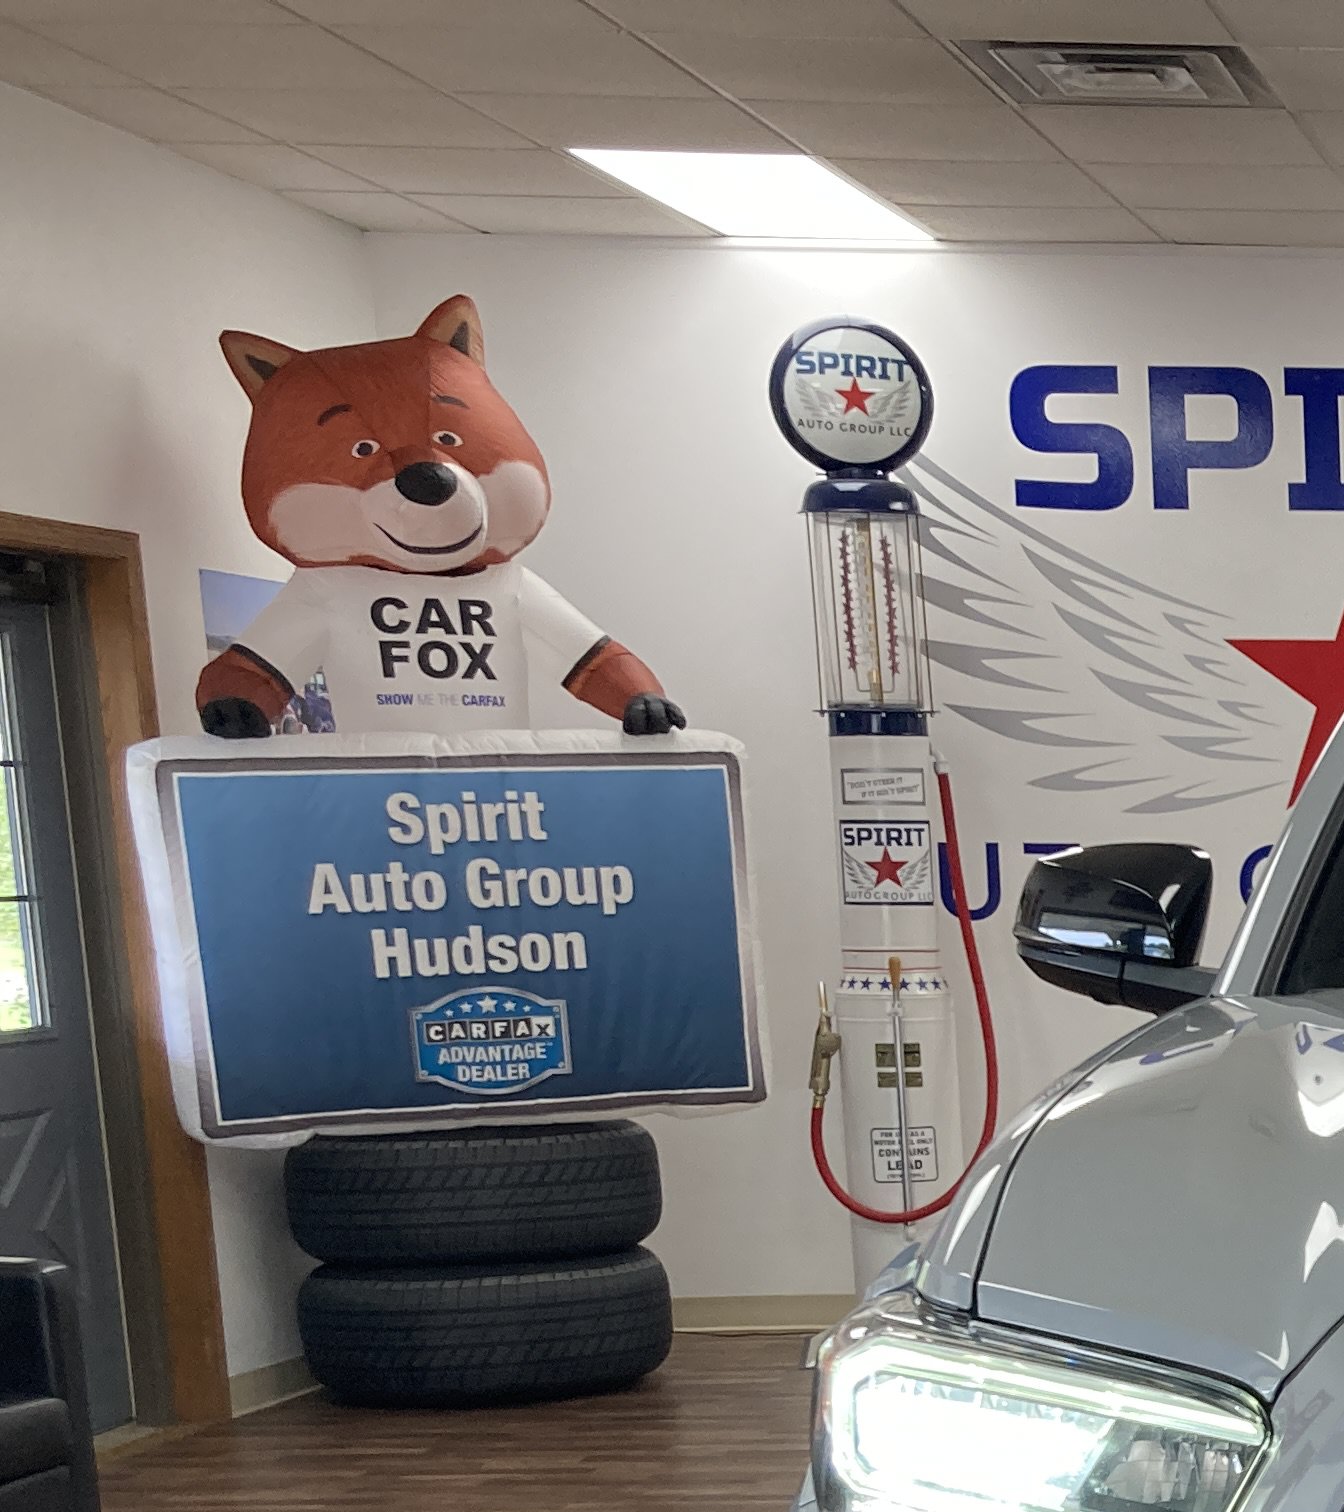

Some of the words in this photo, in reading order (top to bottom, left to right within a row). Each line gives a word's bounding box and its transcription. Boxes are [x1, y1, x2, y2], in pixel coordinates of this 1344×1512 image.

[795, 351, 909, 382] SPIRIT
[797, 418, 834, 431] AUTO
[840, 423, 885, 436] GROUP
[890, 426, 911, 437] LLC
[370, 597, 497, 637] CAR
[379, 640, 497, 681] FOX
[376, 693, 413, 706] SHOW
[462, 694, 506, 707] CARFAX
[385, 790, 548, 855] Spirit
[843, 827, 925, 847] SPIRIT
[308, 861, 447, 915] Auto
[465, 857, 634, 915] Group
[873, 891, 914, 901] GROUP
[370, 925, 588, 979] Hudson
[427, 1018, 553, 1043] CARFAX
[438, 1042, 547, 1065] ADVANTAGE
[457, 1062, 530, 1082] DEALER
[879, 1147, 930, 1157] CONINS
